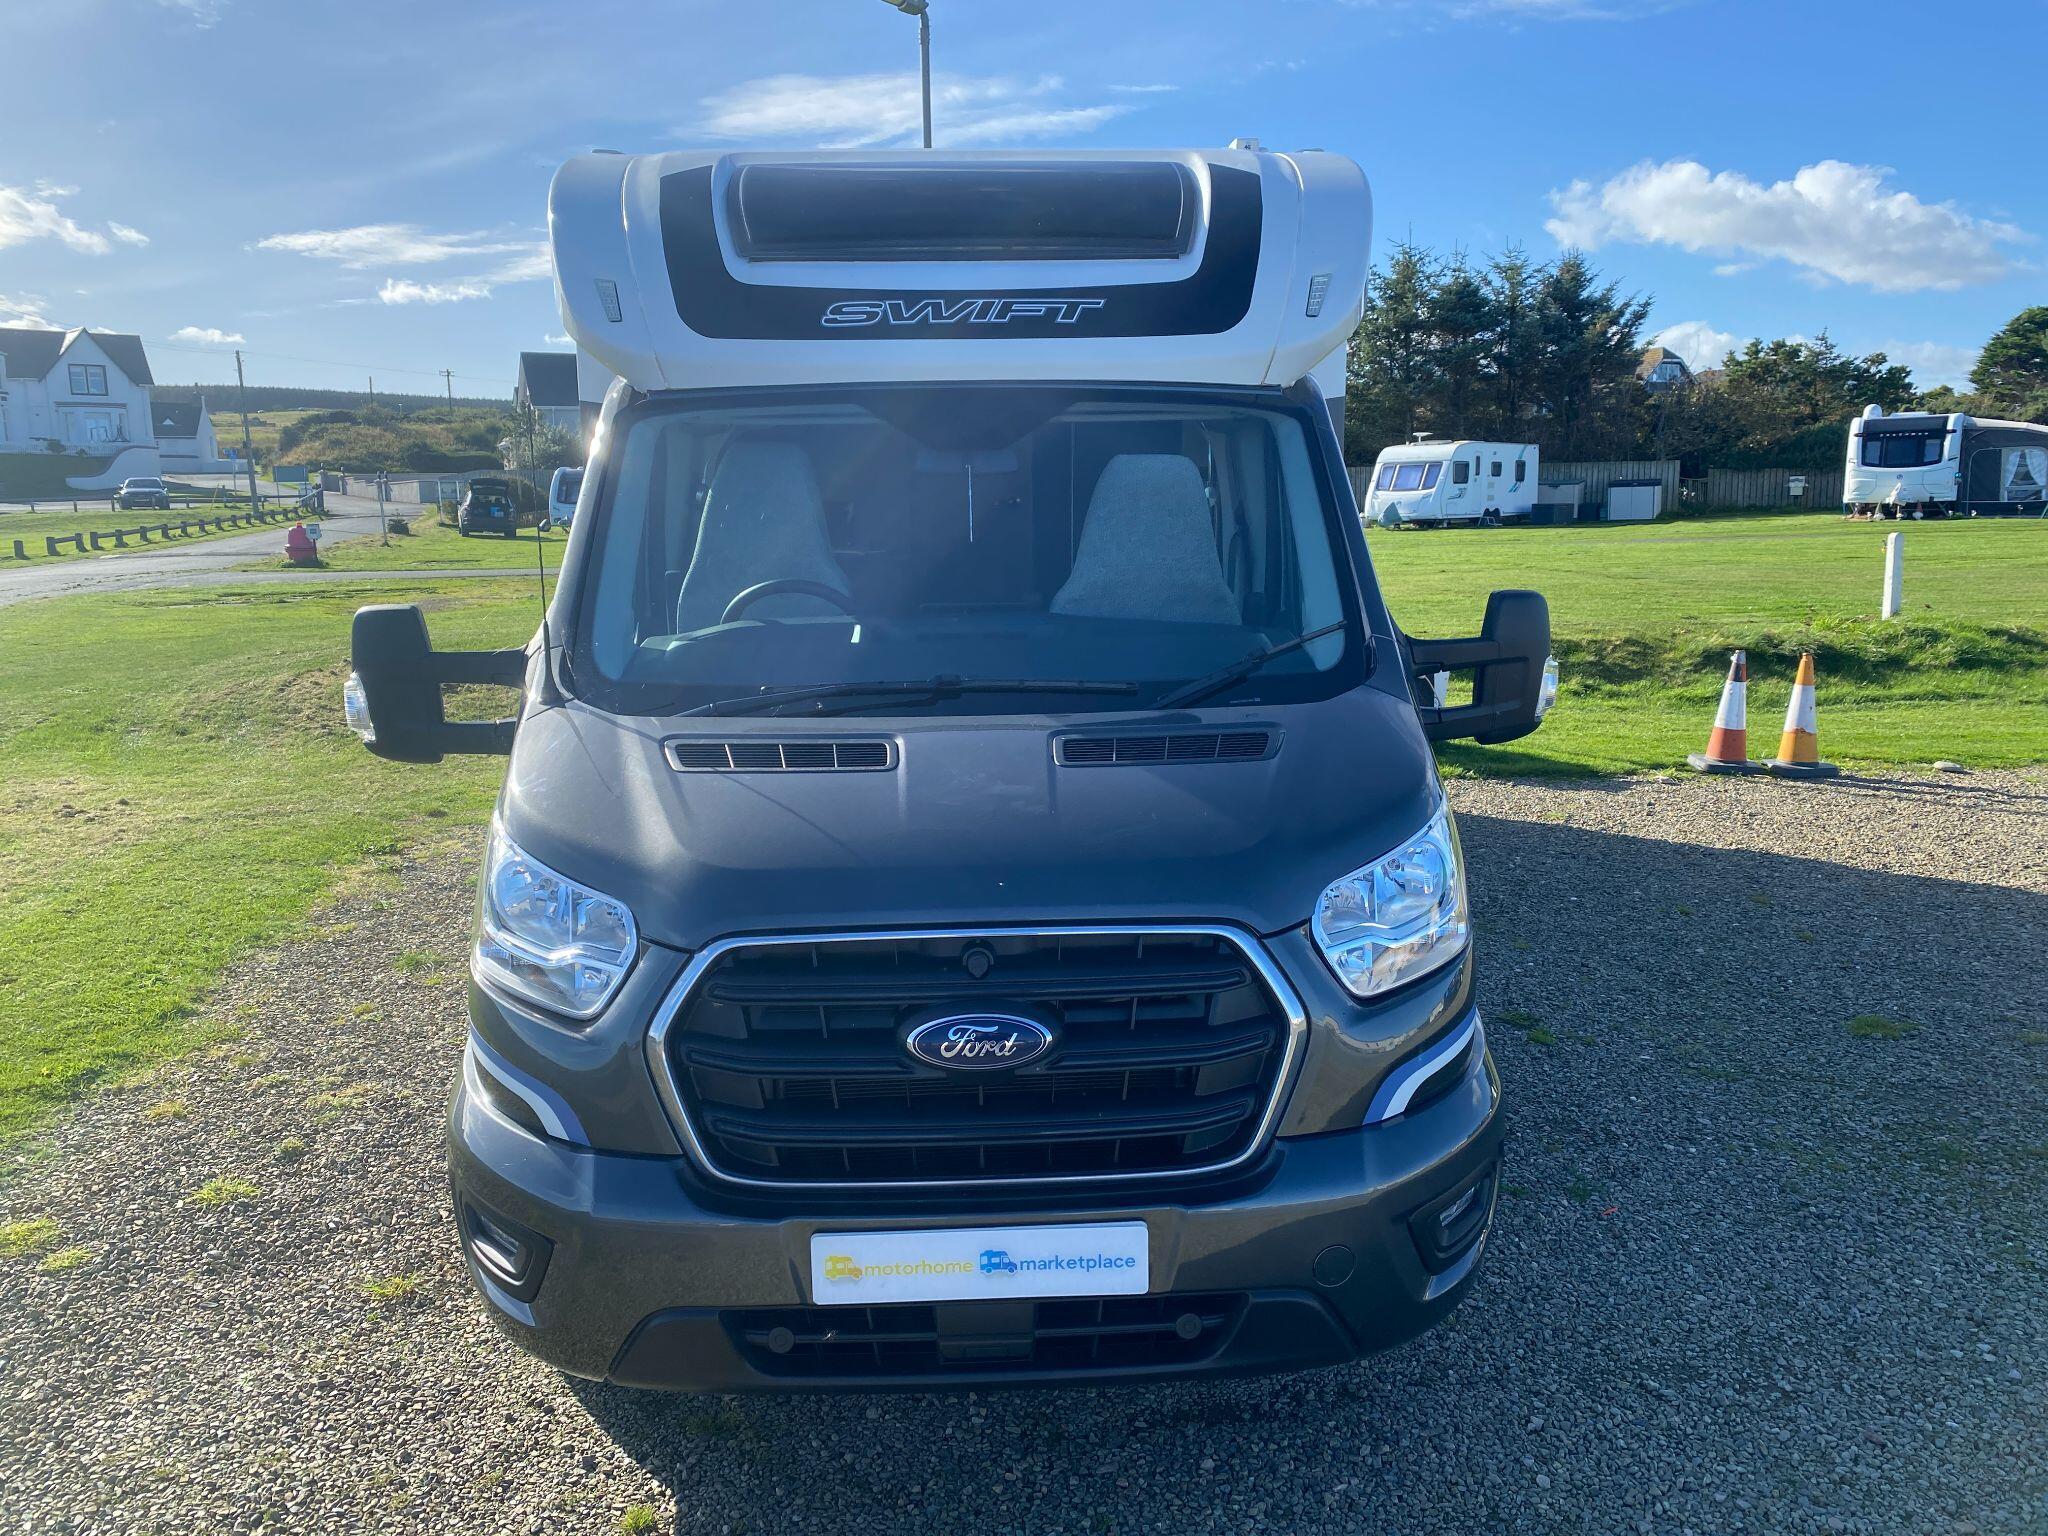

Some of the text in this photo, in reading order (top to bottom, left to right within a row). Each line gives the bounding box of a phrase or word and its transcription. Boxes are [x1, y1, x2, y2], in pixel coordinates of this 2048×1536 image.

[822, 299, 1105, 327] SWIFT
[940, 1025, 1018, 1058] Ford
[864, 1254, 1136, 1276] motorhome marketplace
